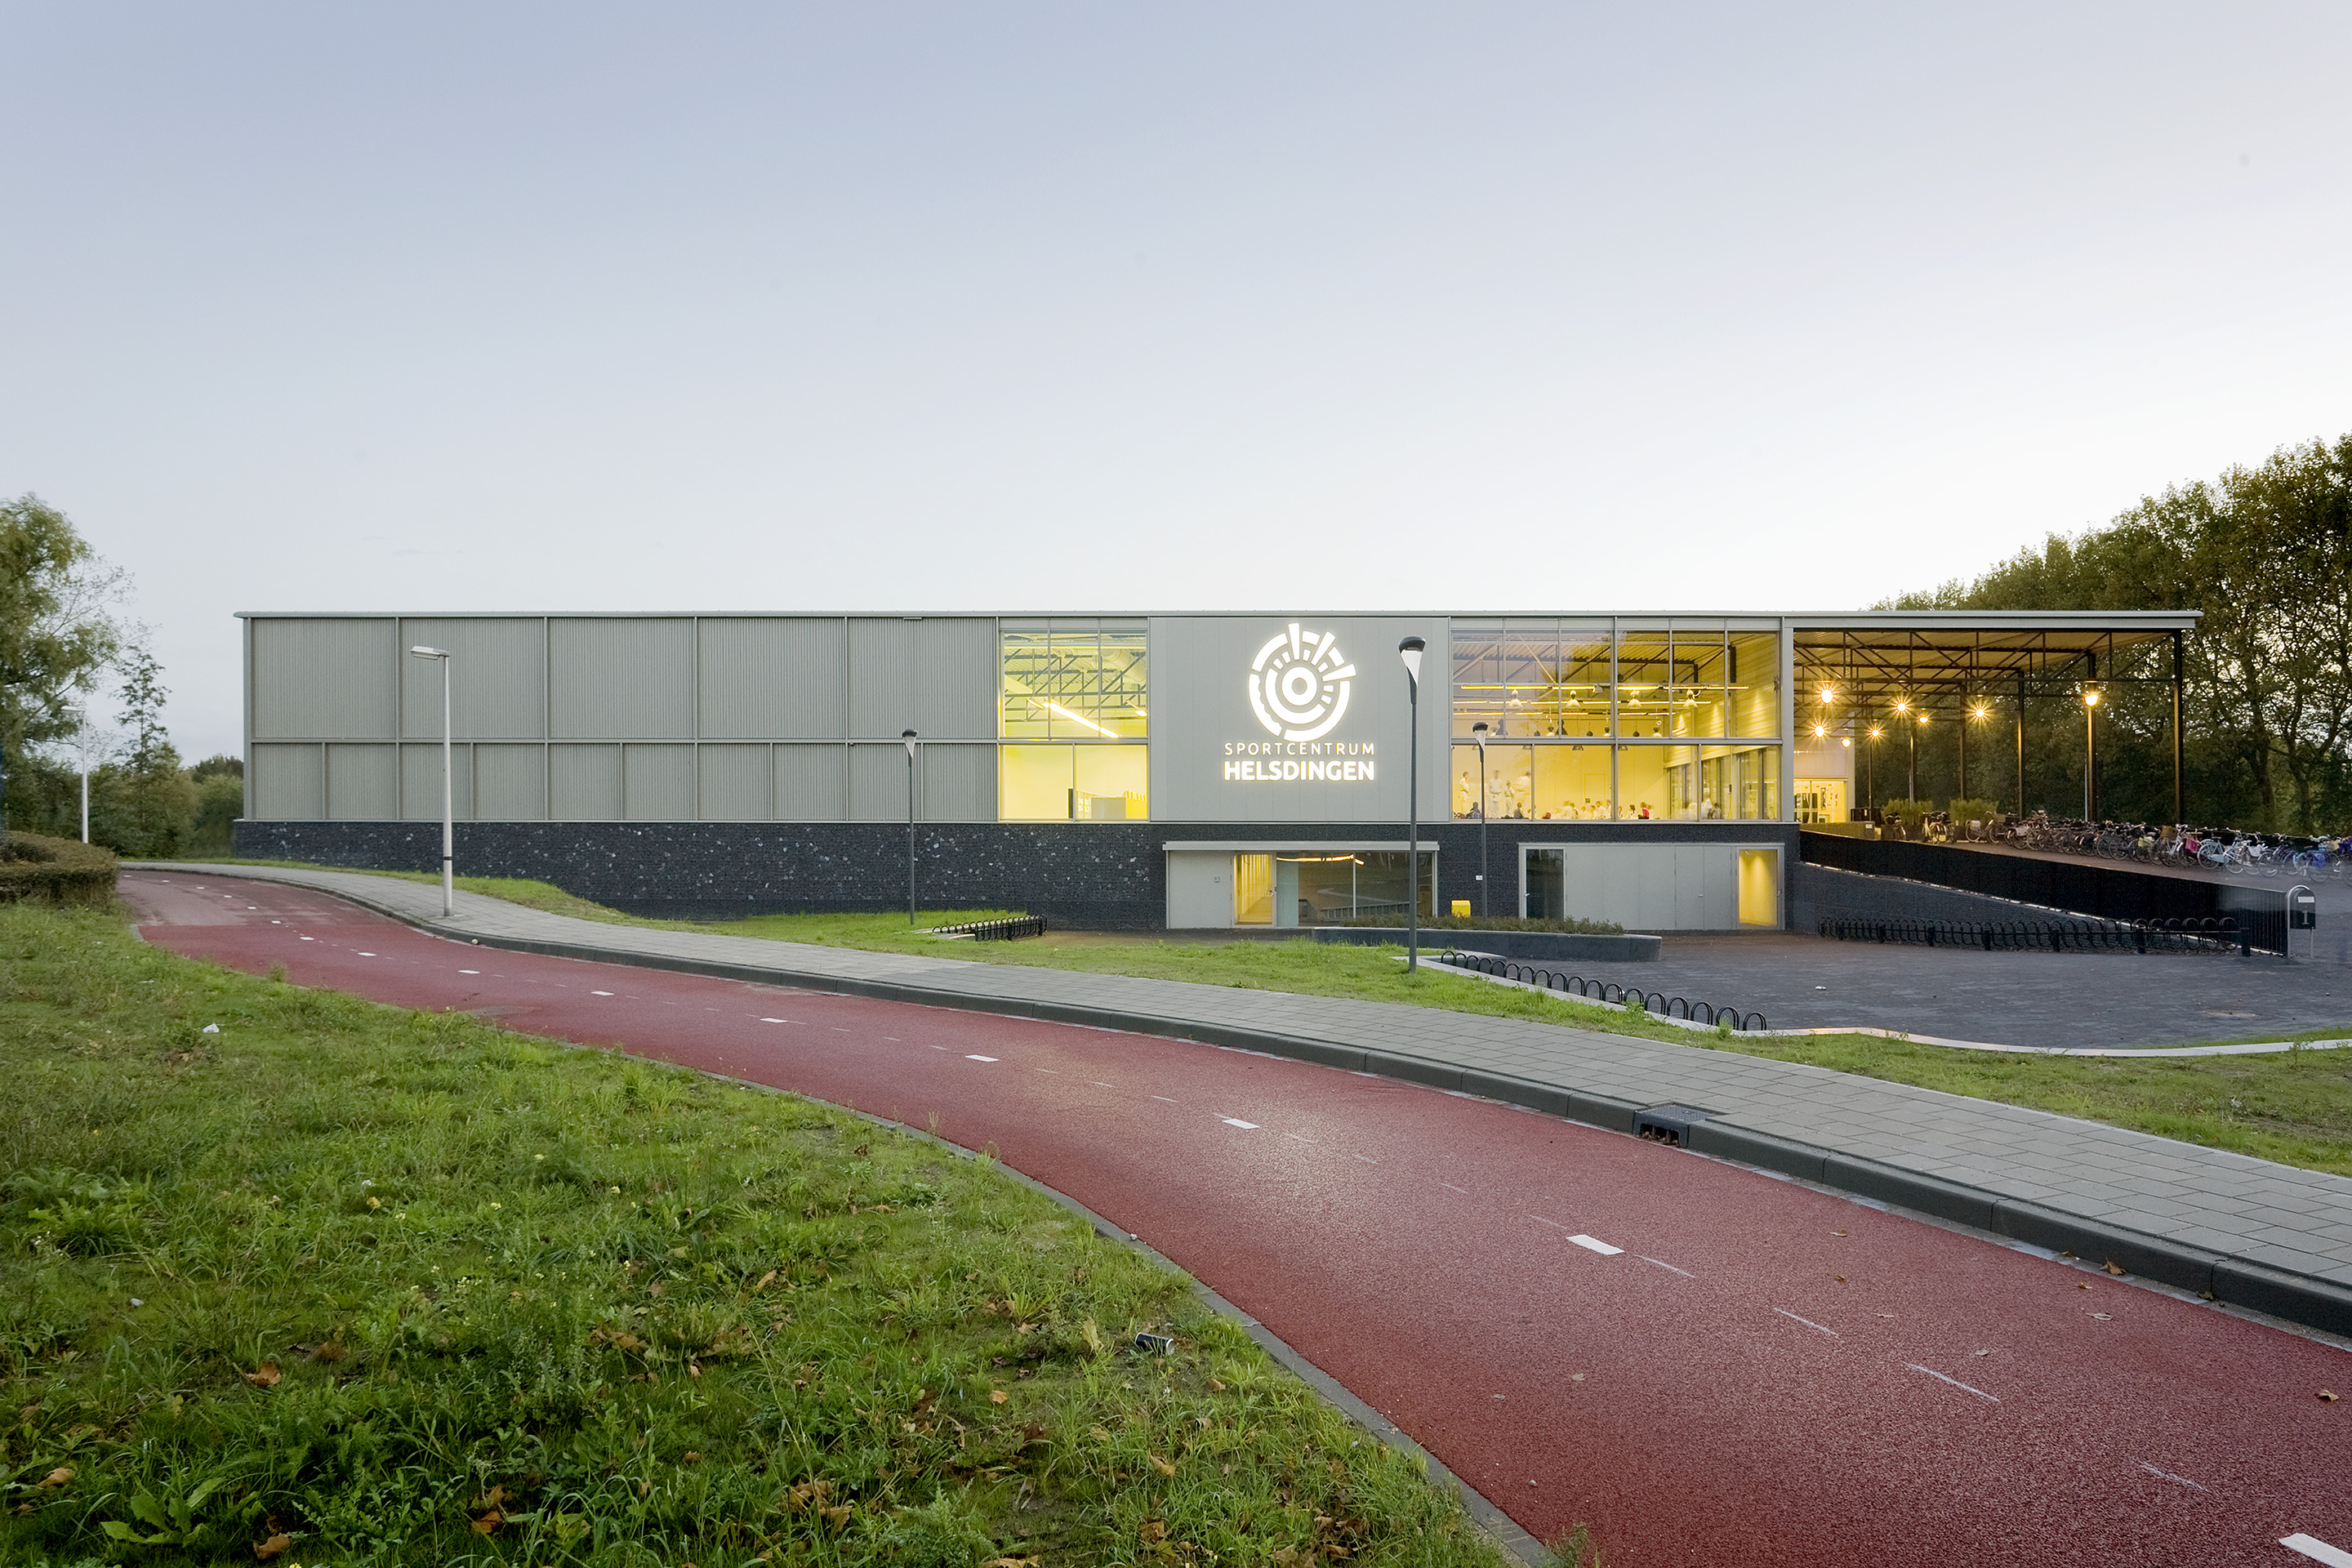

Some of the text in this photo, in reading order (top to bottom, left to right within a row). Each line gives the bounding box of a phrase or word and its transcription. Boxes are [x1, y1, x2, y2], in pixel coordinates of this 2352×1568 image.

[1224, 742, 1374, 755] SPORTCENTRUM
[1224, 760, 1374, 781] HELSDINGEN
[2301, 910, 2310, 924] 1
